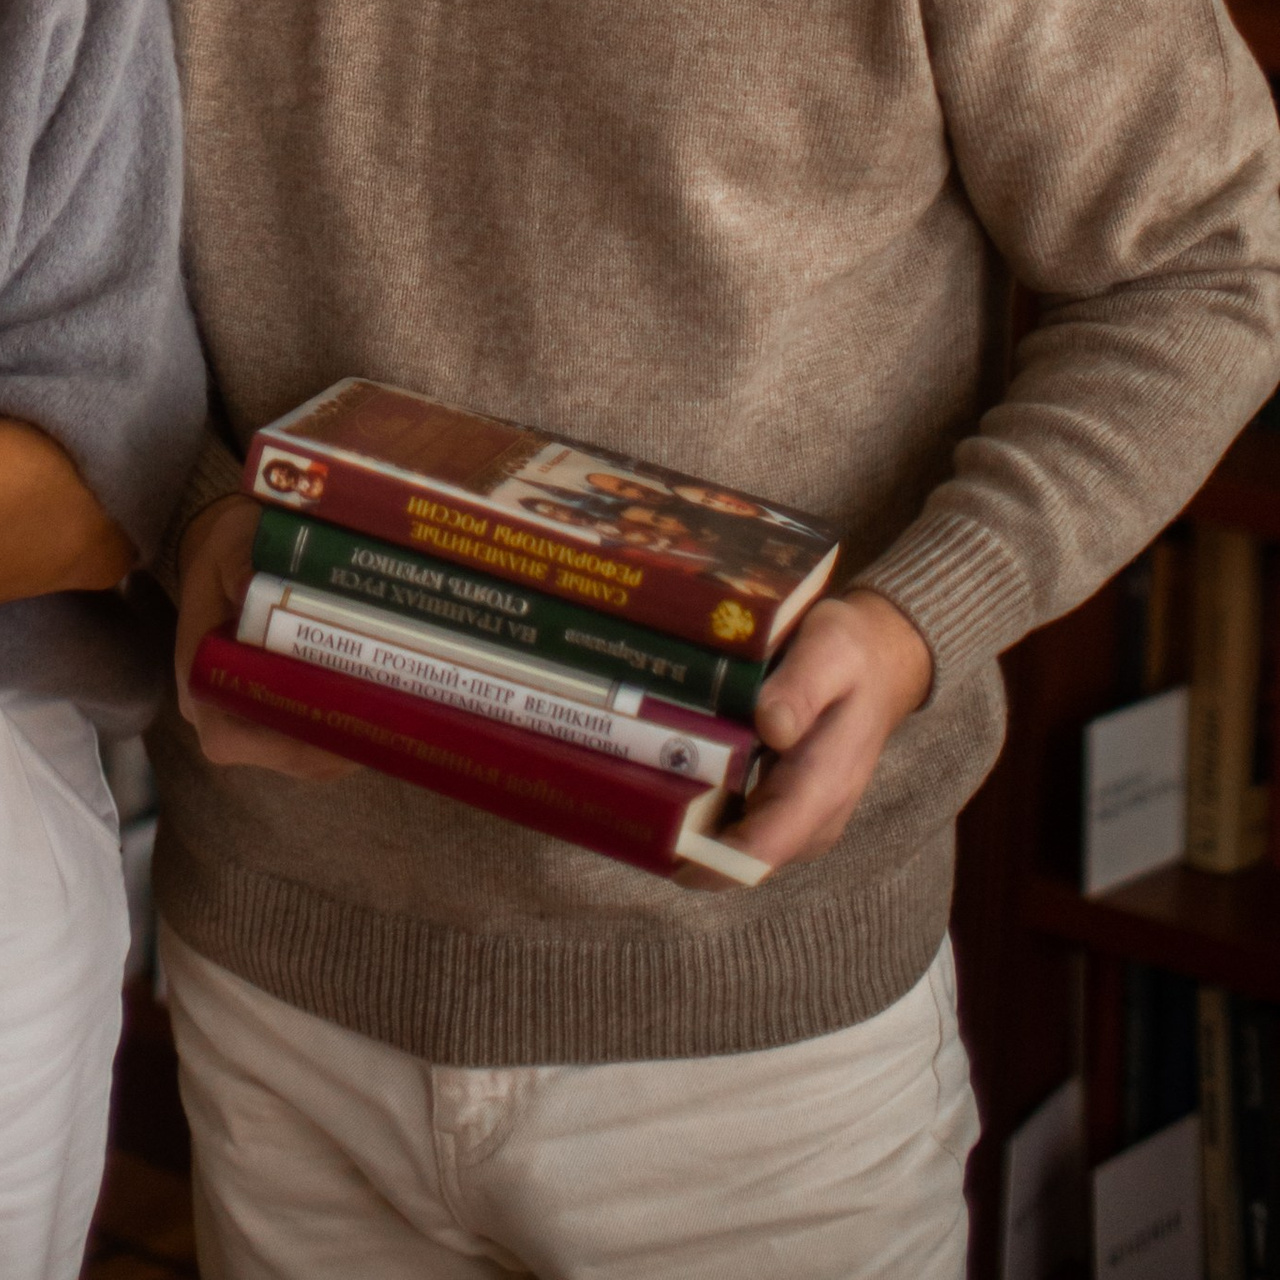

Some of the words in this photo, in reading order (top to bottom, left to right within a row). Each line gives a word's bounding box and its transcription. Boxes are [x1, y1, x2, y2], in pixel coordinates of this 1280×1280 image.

[405, 495, 488, 536] РОССИИ
[350, 546, 444, 590] КРЕПКО!
[407, 520, 548, 580] ЗНАМЕНИТЫЕ
[492, 522, 644, 587] РЕФОРМАТОРЫ
[328, 565, 388, 598] РУСИ
[445, 575, 531, 617] СТОЯТЬ
[554, 568, 629, 606] САМЫЕ
[389, 583, 503, 634] ГРАНИЦАХ
[503, 618, 538, 644] НА
[295, 622, 364, 658] ИОАНН
[371, 646, 461, 689] ГРОЗНЫЙ
[468, 678, 516, 706] ПЕТР
[522, 695, 614, 736] ВЕЛИКИЙ
